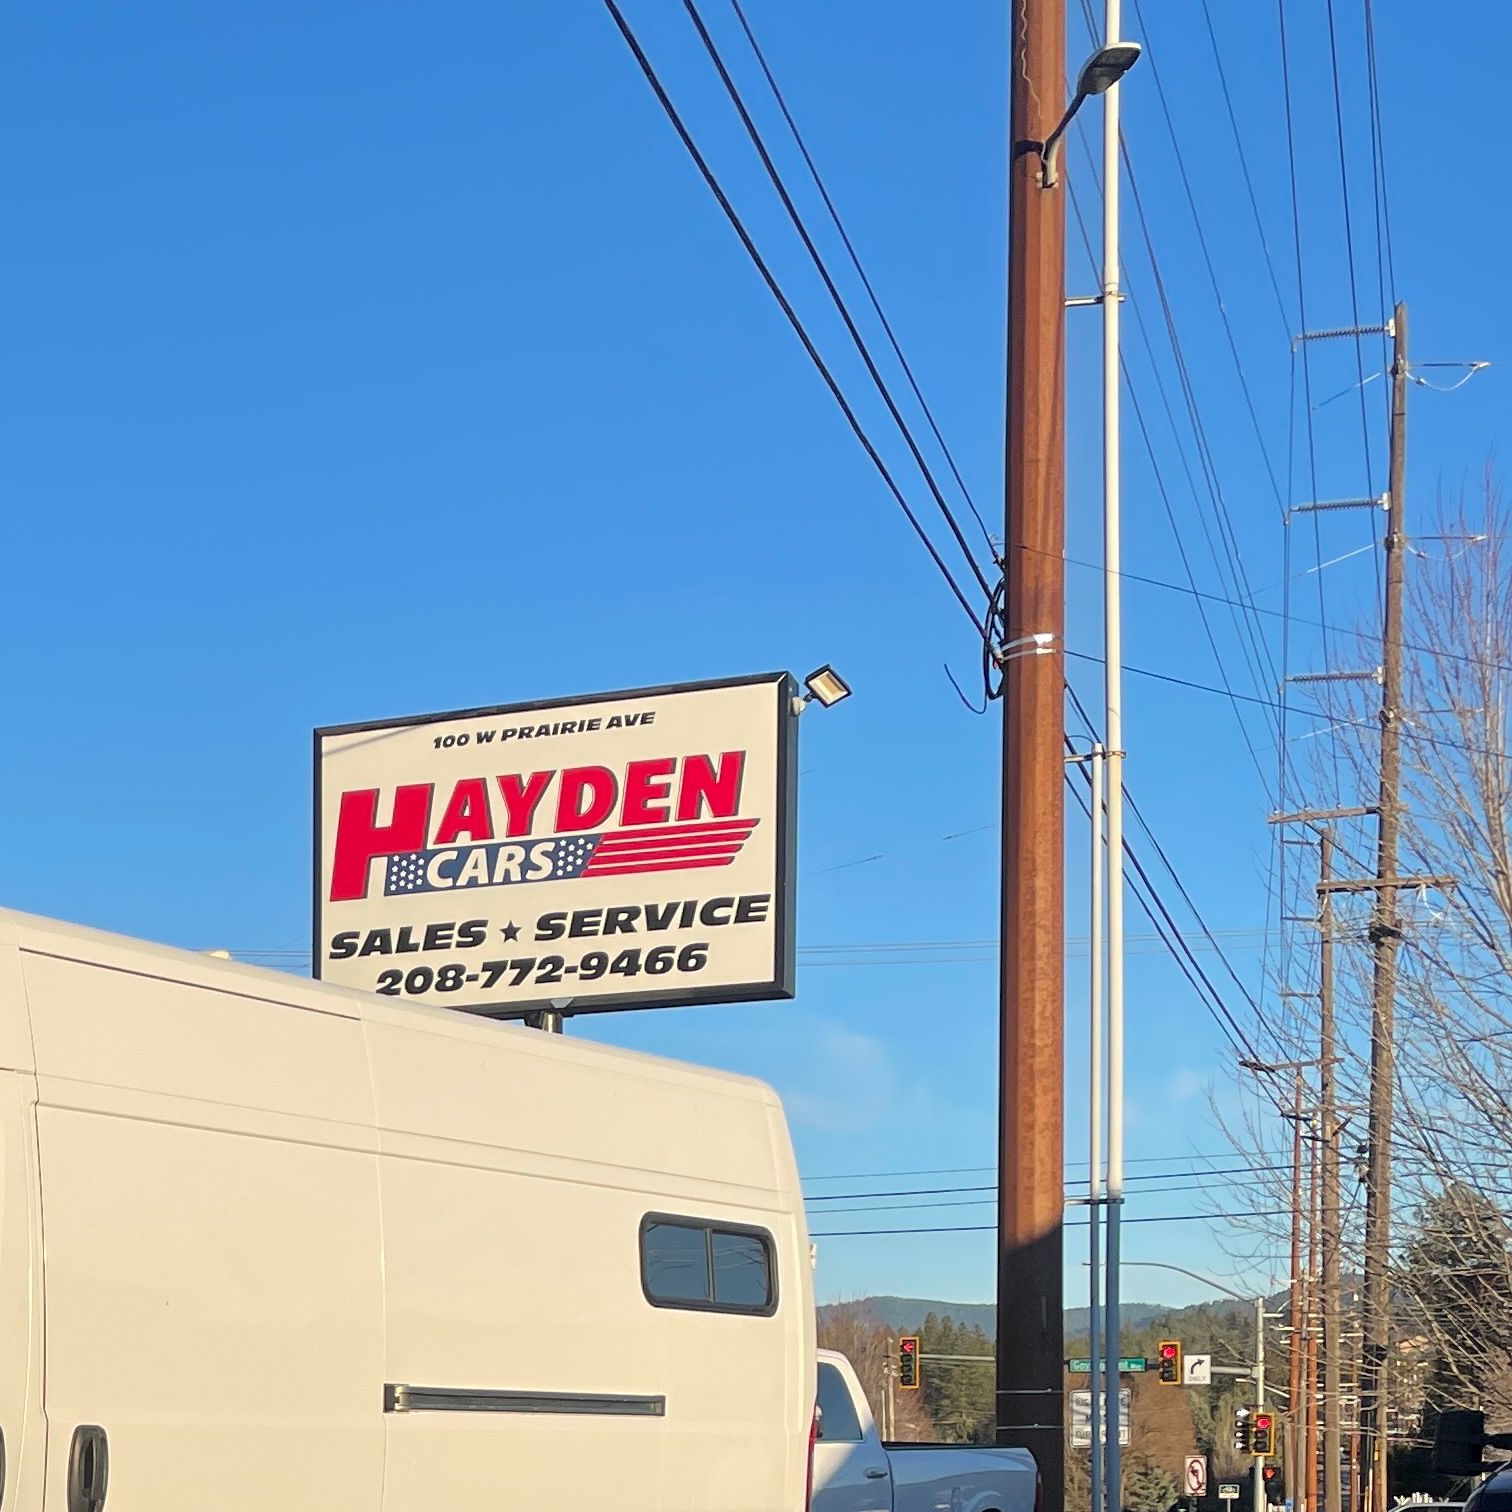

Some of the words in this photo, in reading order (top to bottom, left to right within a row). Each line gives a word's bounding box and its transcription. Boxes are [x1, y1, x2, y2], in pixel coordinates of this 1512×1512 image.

[433, 733, 470, 749] 100
[476, 730, 496, 745] W
[501, 717, 603, 742] PRAIRIE
[606, 711, 656, 730] AVE
[330, 750, 746, 902] HAYDEN
[426, 841, 556, 888] CARS
[329, 919, 489, 960] SALES
[534, 893, 771, 942] SERVICE
[376, 942, 710, 995] 208-772-9466
